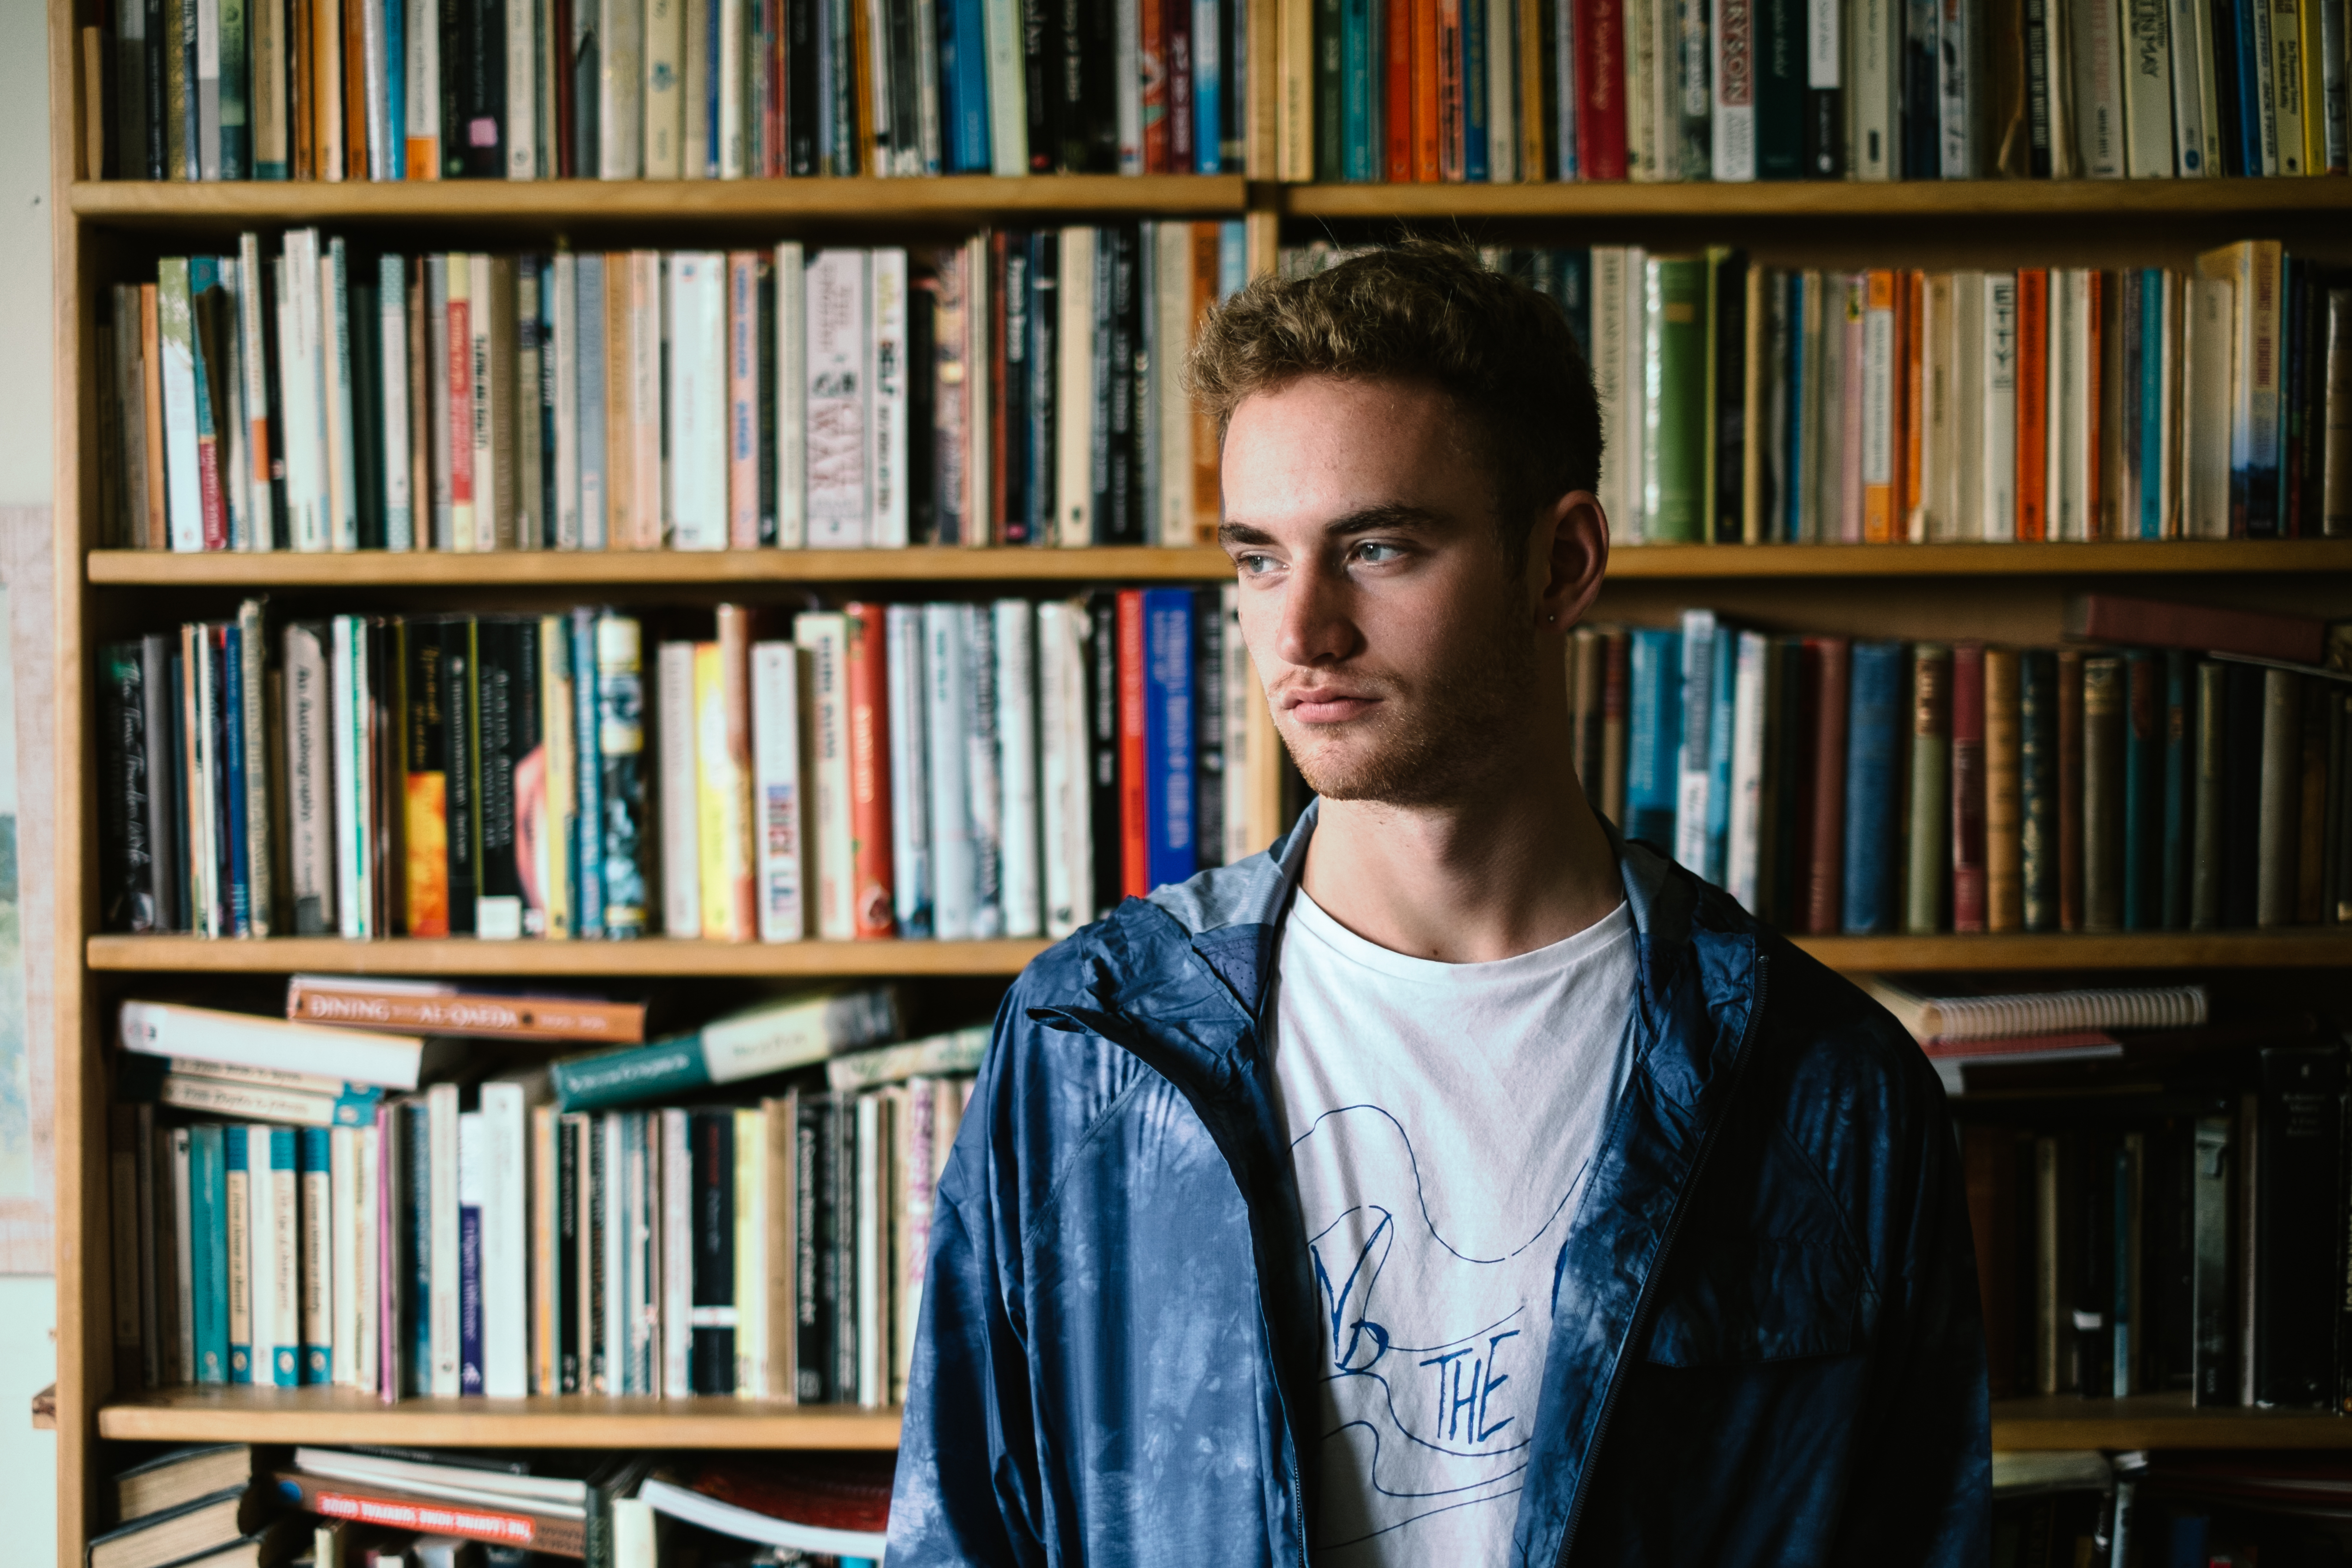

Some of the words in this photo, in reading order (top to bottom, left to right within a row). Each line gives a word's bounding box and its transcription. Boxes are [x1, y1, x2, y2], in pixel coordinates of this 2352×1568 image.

[2141, 37, 2159, 78] MAY
[294, 697, 316, 821] Autobiography
[309, 993, 390, 1022] DINING
[1420, 1330, 1520, 1445] THE
[321, 1497, 359, 1515] GUIDE
[419, 1508, 453, 1527] HOME
